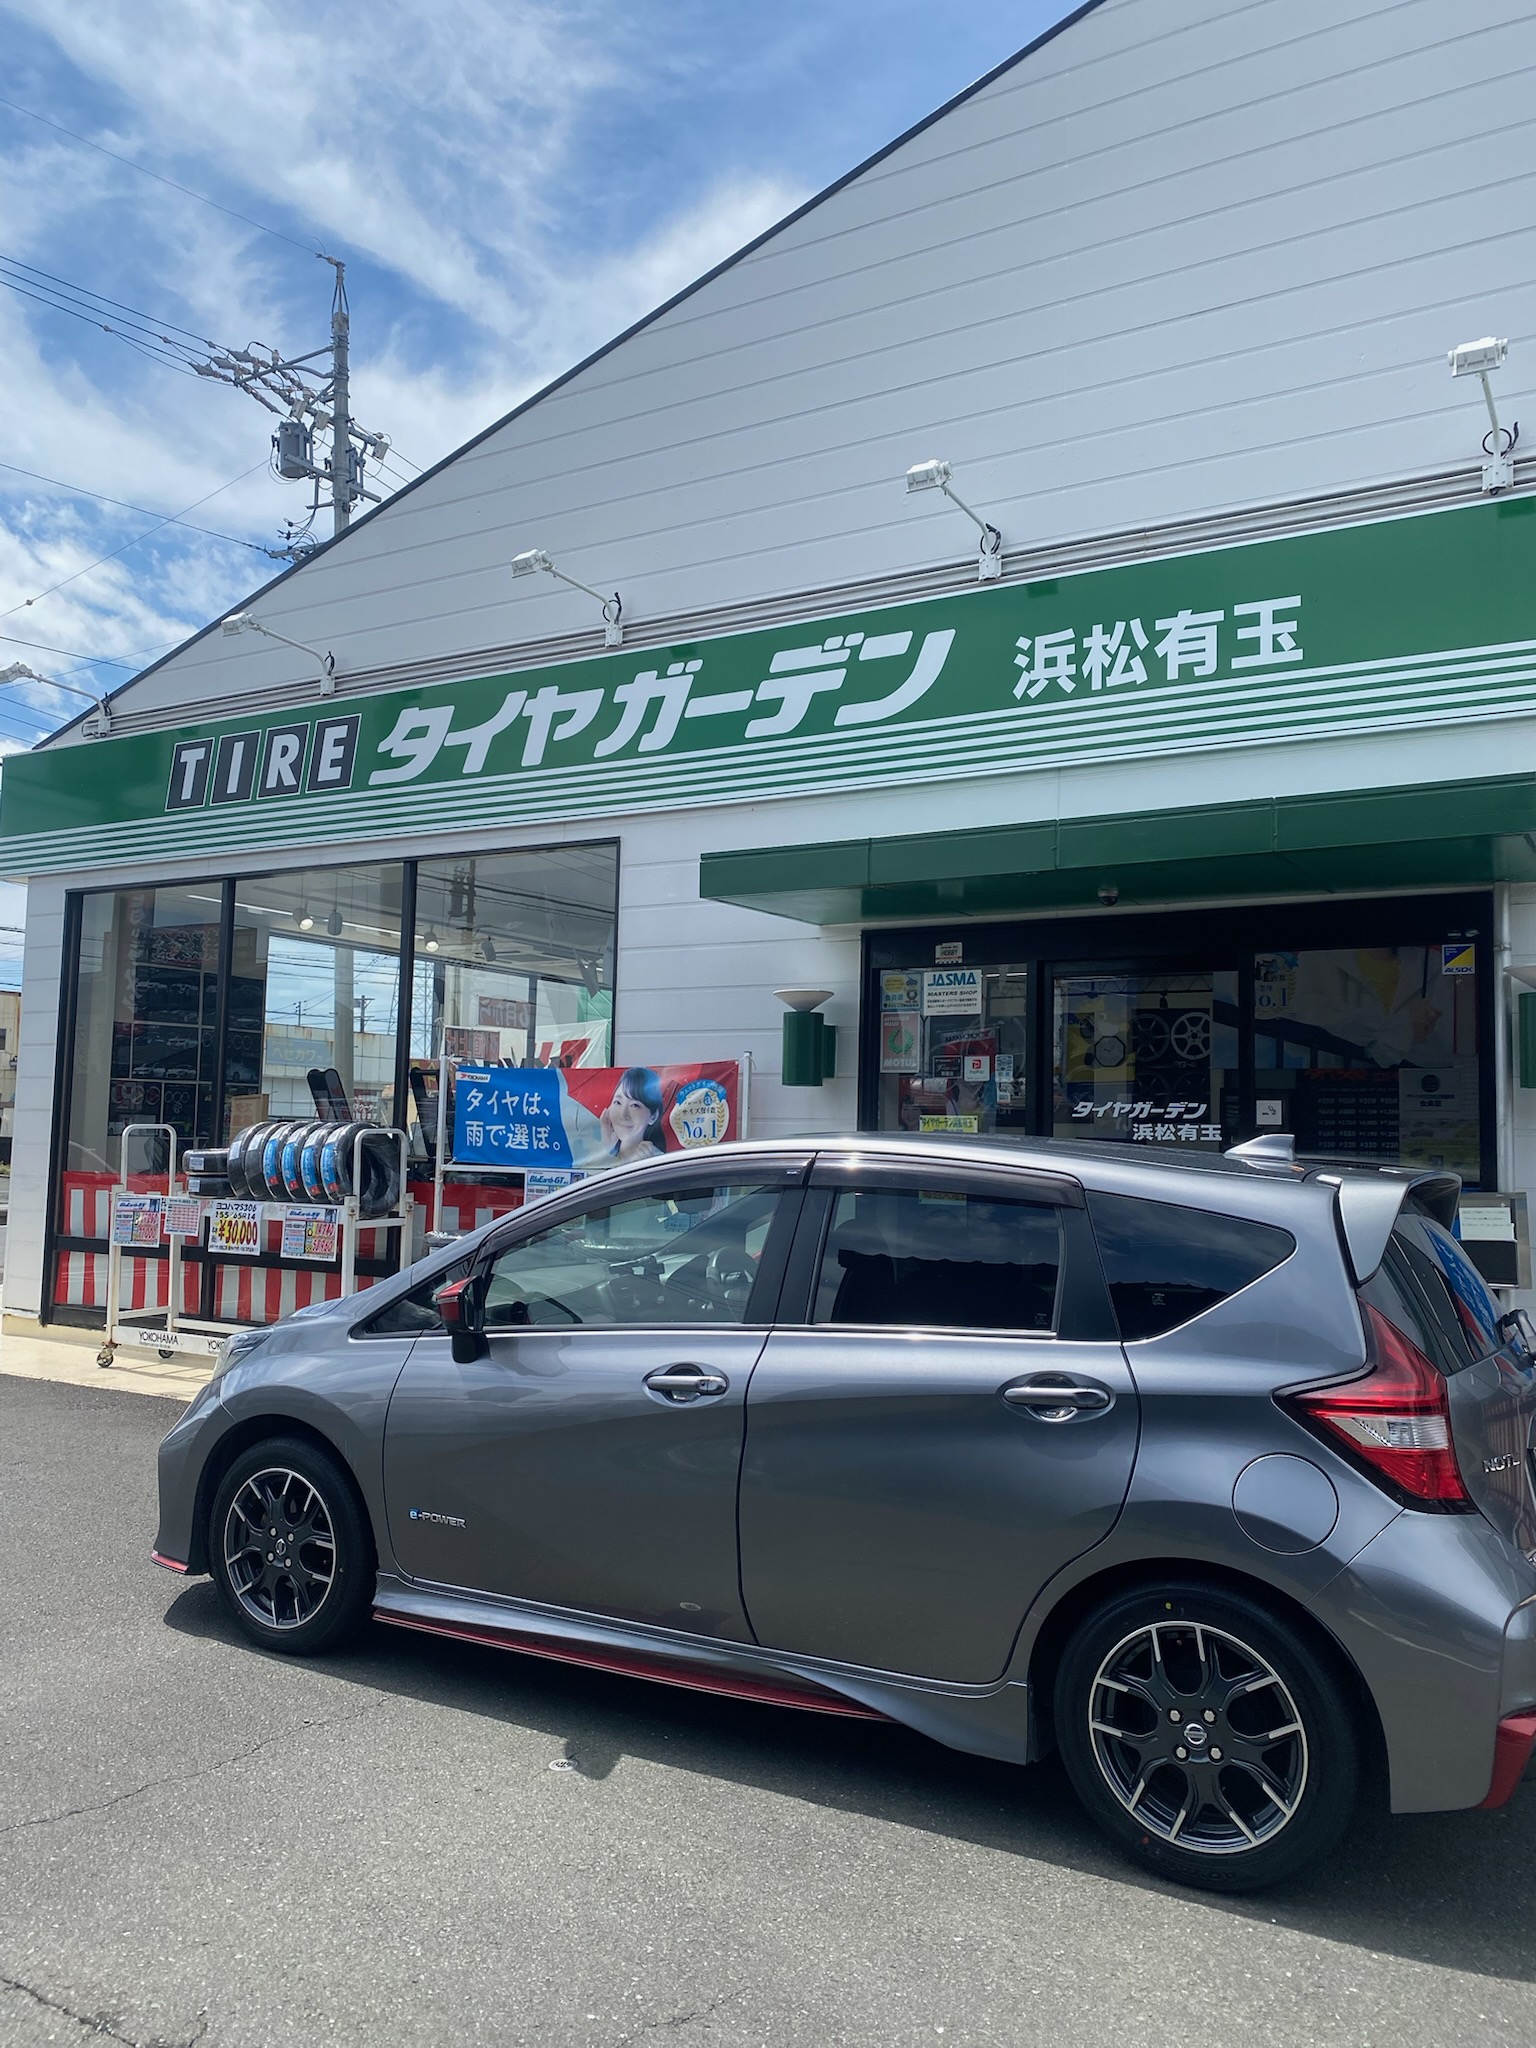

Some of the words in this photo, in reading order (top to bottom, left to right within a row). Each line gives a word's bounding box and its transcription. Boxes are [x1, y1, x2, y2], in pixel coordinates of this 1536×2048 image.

[1012, 595, 1304, 700] 浜松有玉
[368, 629, 957, 787] タイヤガーデン
[179, 723, 351, 800] TIRE
[927, 972, 977, 987] JASMA
[466, 1088, 550, 1117] タイヤは、
[1071, 1101, 1208, 1119] タイヤガーデン
[465, 1120, 561, 1151] 雨で選ぼ。
[681, 1119, 718, 1139] No.1
[1132, 1123, 1222, 1142] 浜松有玉
[215, 1211, 256, 1220] 155/65R14
[216, 1202, 258, 1212] ヨコハマS306
[218, 1219, 258, 1246] ¥30,000
[138, 1331, 179, 1345] YOKOHAMA
[207, 1339, 225, 1350] YOKO
[409, 1508, 467, 1529] e-POWER
